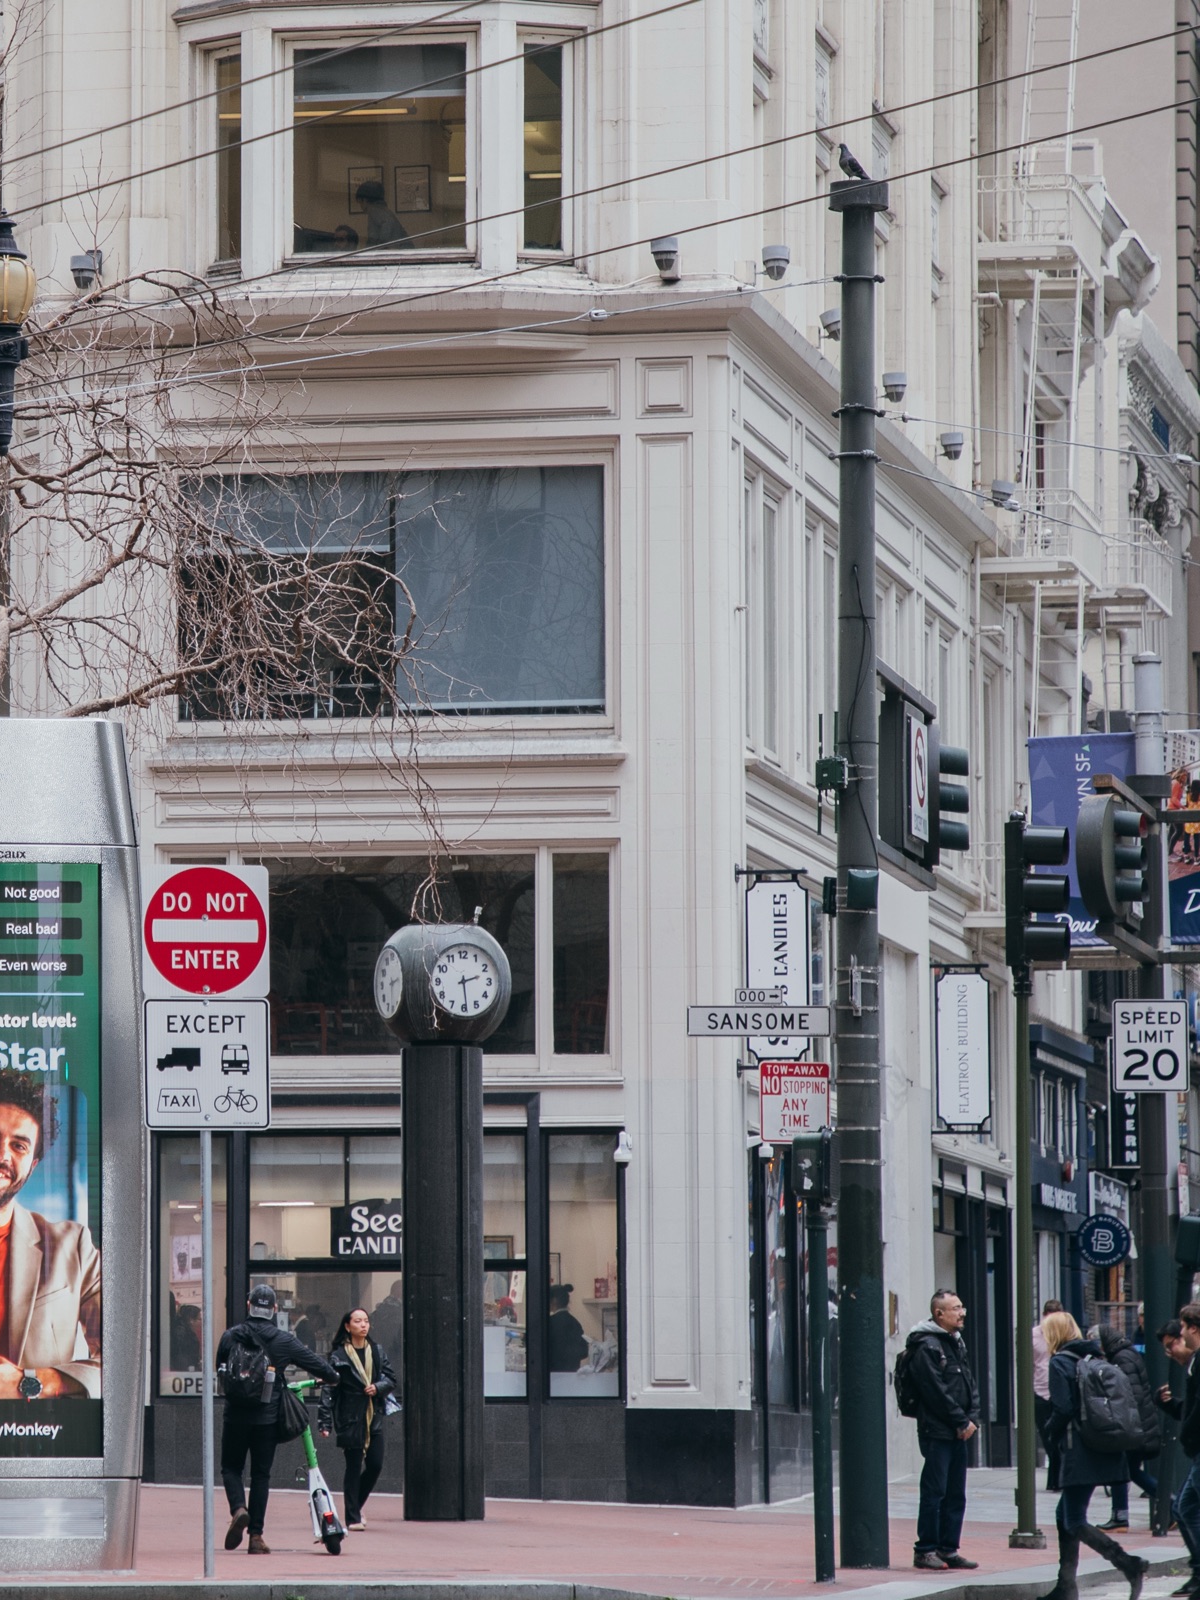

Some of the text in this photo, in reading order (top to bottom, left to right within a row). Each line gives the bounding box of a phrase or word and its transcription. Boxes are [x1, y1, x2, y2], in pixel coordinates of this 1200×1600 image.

[1075, 753, 1091, 772] SF
[4, 887, 60, 901] Not good
[162, 892, 248, 912] DO NOT
[6, 923, 58, 934] Real bad
[773, 894, 788, 976] CANDIES
[171, 949, 240, 970] ENTER
[446, 954, 455, 963] 11
[458, 950, 468, 960] 12
[473, 954, 478, 963] 1
[0, 959, 67, 971] Even worse
[437, 964, 448, 973] 10
[482, 963, 488, 972] 2
[435, 977, 441, 986] 9
[486, 977, 492, 986] 3
[439, 991, 445, 1000] 8
[482, 990, 489, 999] 4
[449, 1000, 455, 1009] 7
[461, 1003, 467, 1012] 6
[473, 1000, 480, 1009] 5
[32, 1012, 77, 1028] level:
[167, 1015, 246, 1033] EXCEPT
[707, 1013, 810, 1030] SANSOME
[1120, 1011, 1181, 1025] SPEED
[1127, 1030, 1174, 1043] LIMIT
[957, 984, 969, 1114] FLATIRON BUILDING
[766, 1065, 824, 1075] TOW-AWAY
[1123, 1048, 1180, 1081] 20
[762, 1076, 826, 1094] NO STOPPING
[161, 1095, 195, 1107] TAXI
[782, 1098, 808, 1111] ANY
[781, 1114, 810, 1127] TIME
[1124, 1091, 1137, 1163] AVERN
[351, 1206, 402, 1233] See
[339, 1236, 402, 1254] CAND
[1091, 1228, 1115, 1253] B
